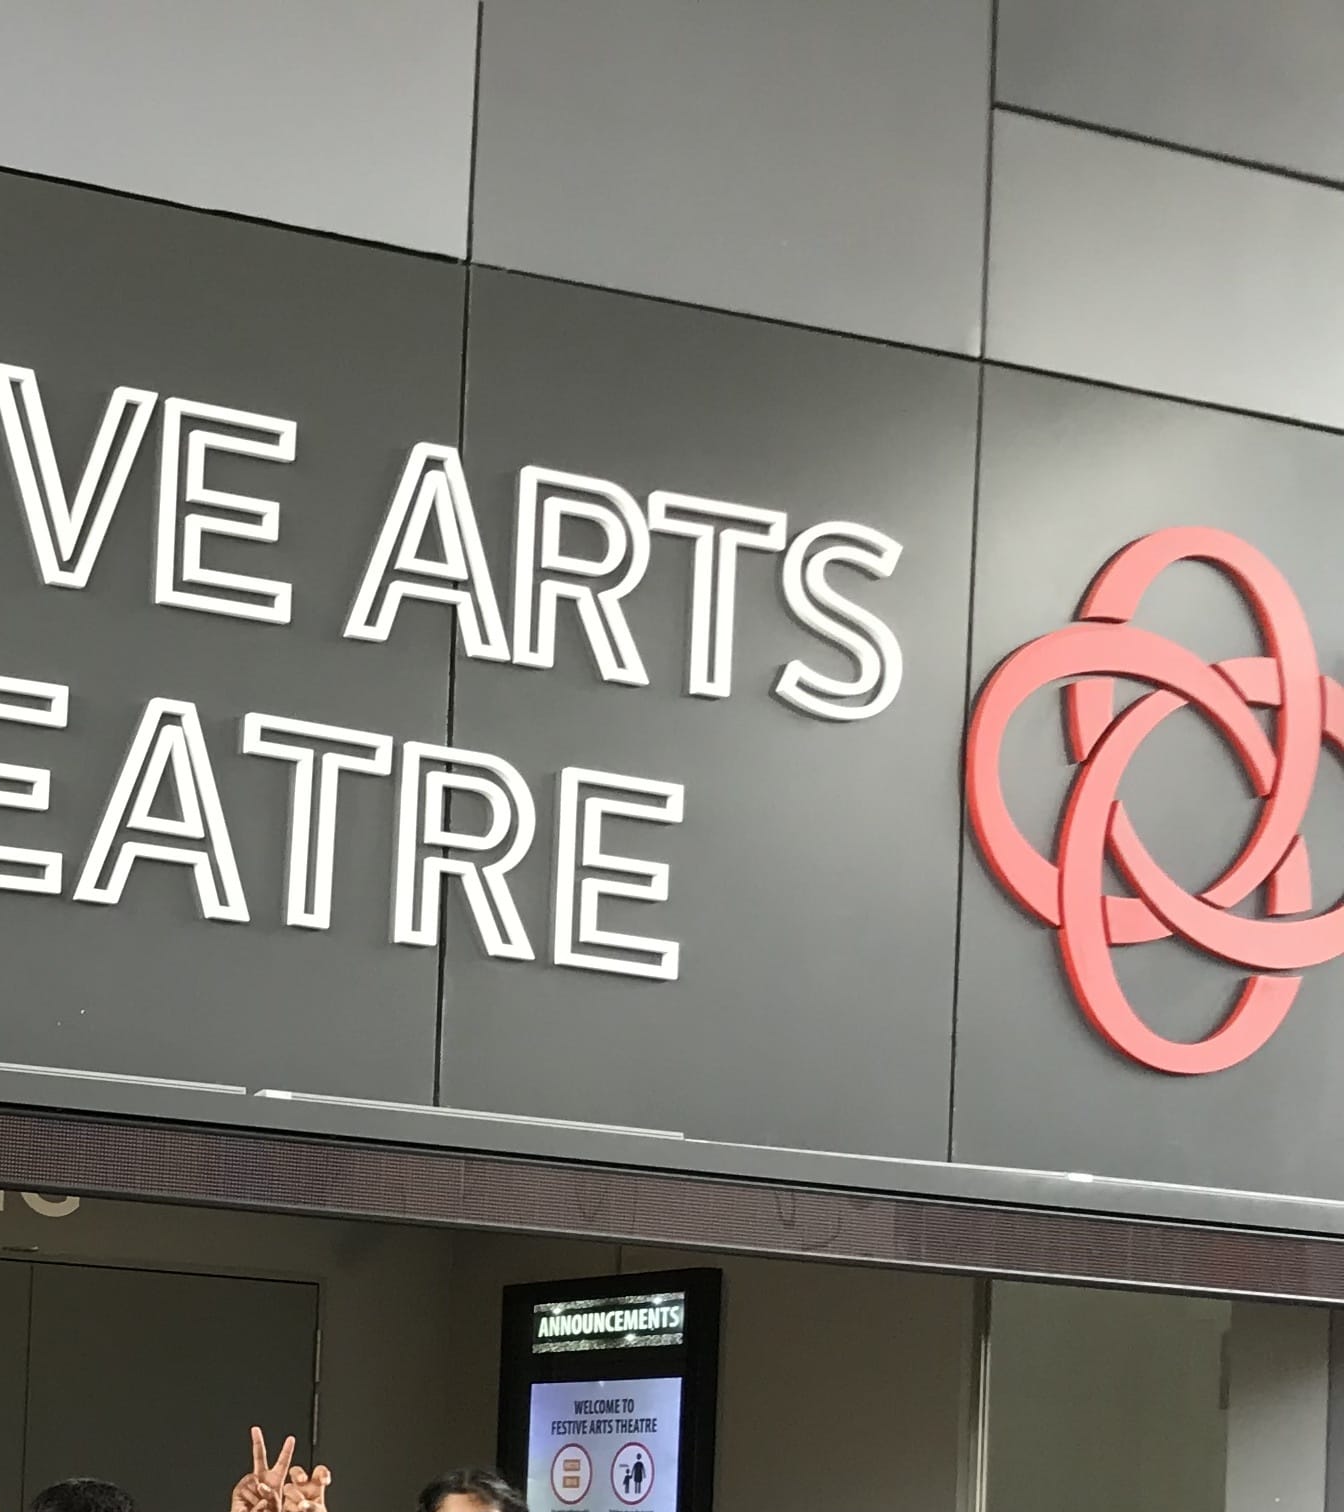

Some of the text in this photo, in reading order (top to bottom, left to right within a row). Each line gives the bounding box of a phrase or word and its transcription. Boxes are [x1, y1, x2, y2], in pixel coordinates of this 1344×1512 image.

[342, 438, 906, 724] ARTS
[538, 1305, 680, 1338] ANNOUNCEMENTS
[574, 1399, 635, 1415] WELCOME TO
[551, 1418, 658, 1436] FESTIVE ARTS THEATRE
